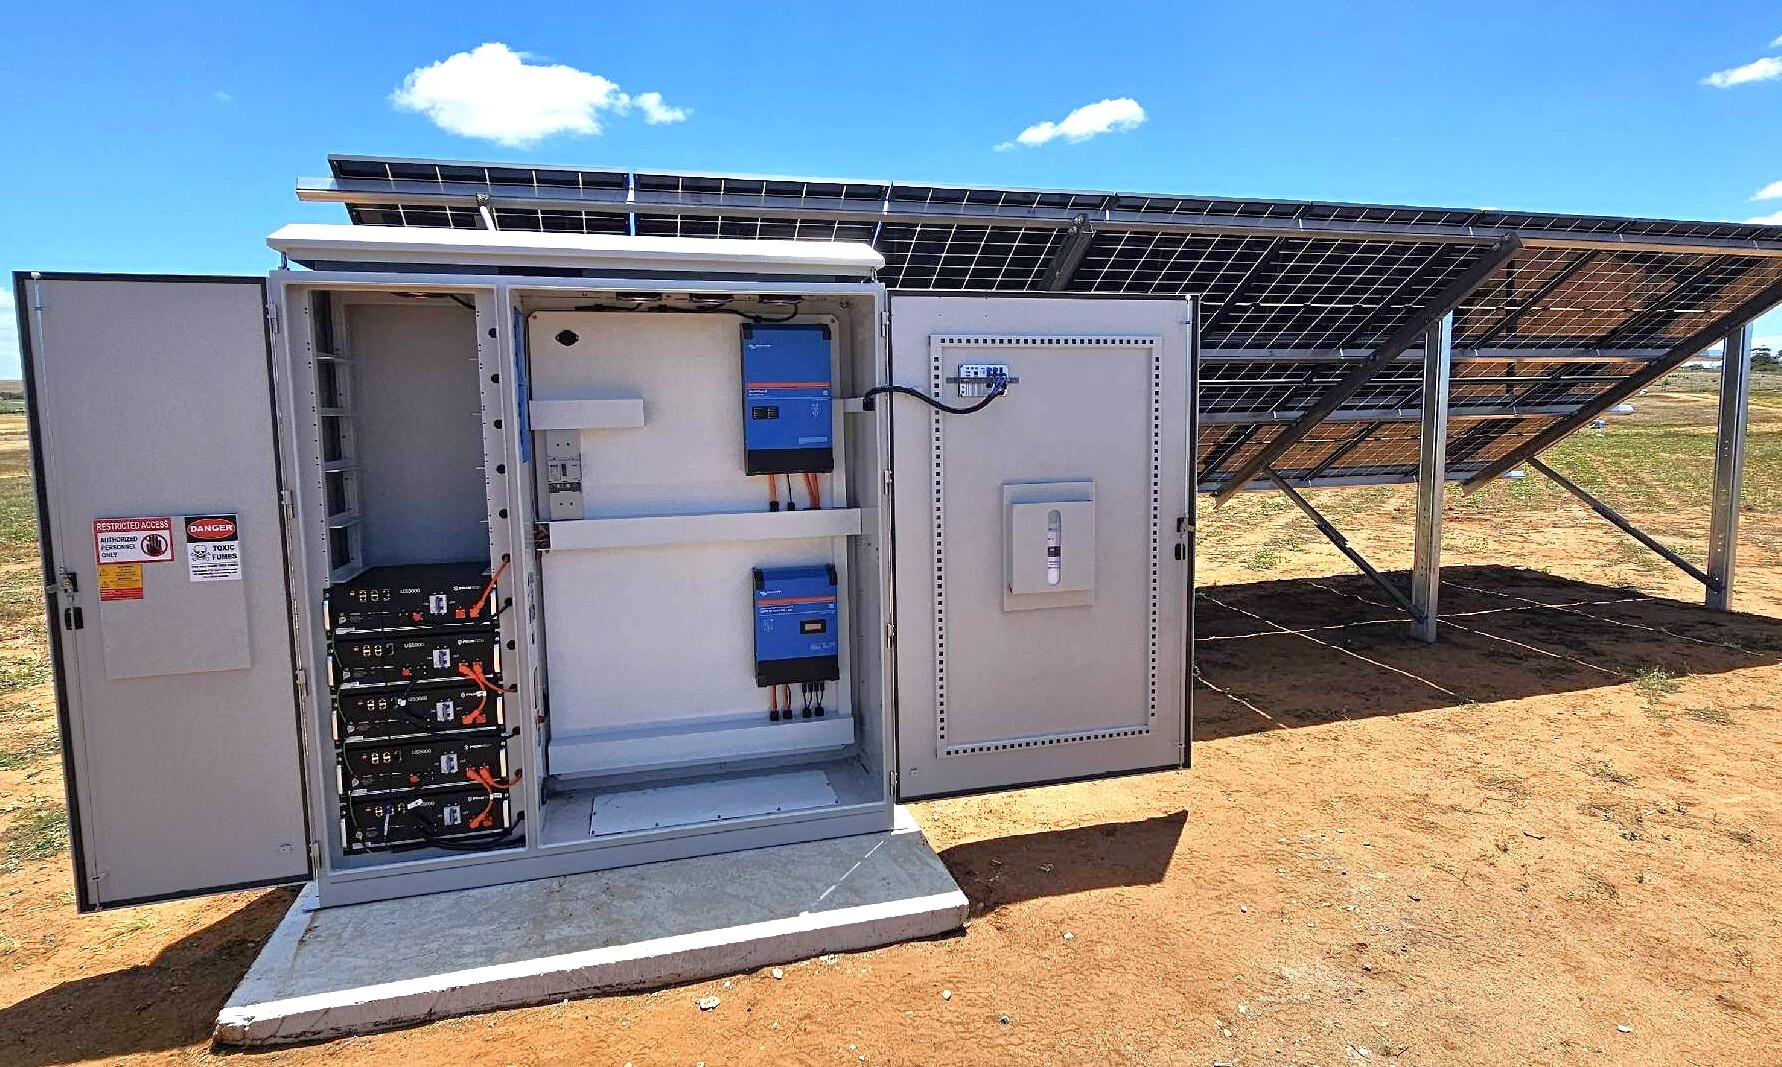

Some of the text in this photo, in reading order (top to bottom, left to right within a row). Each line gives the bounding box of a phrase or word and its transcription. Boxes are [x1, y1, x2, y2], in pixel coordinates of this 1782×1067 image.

[96, 520, 169, 531] RESTRICTED ACCESS
[190, 524, 233, 533] DANGER
